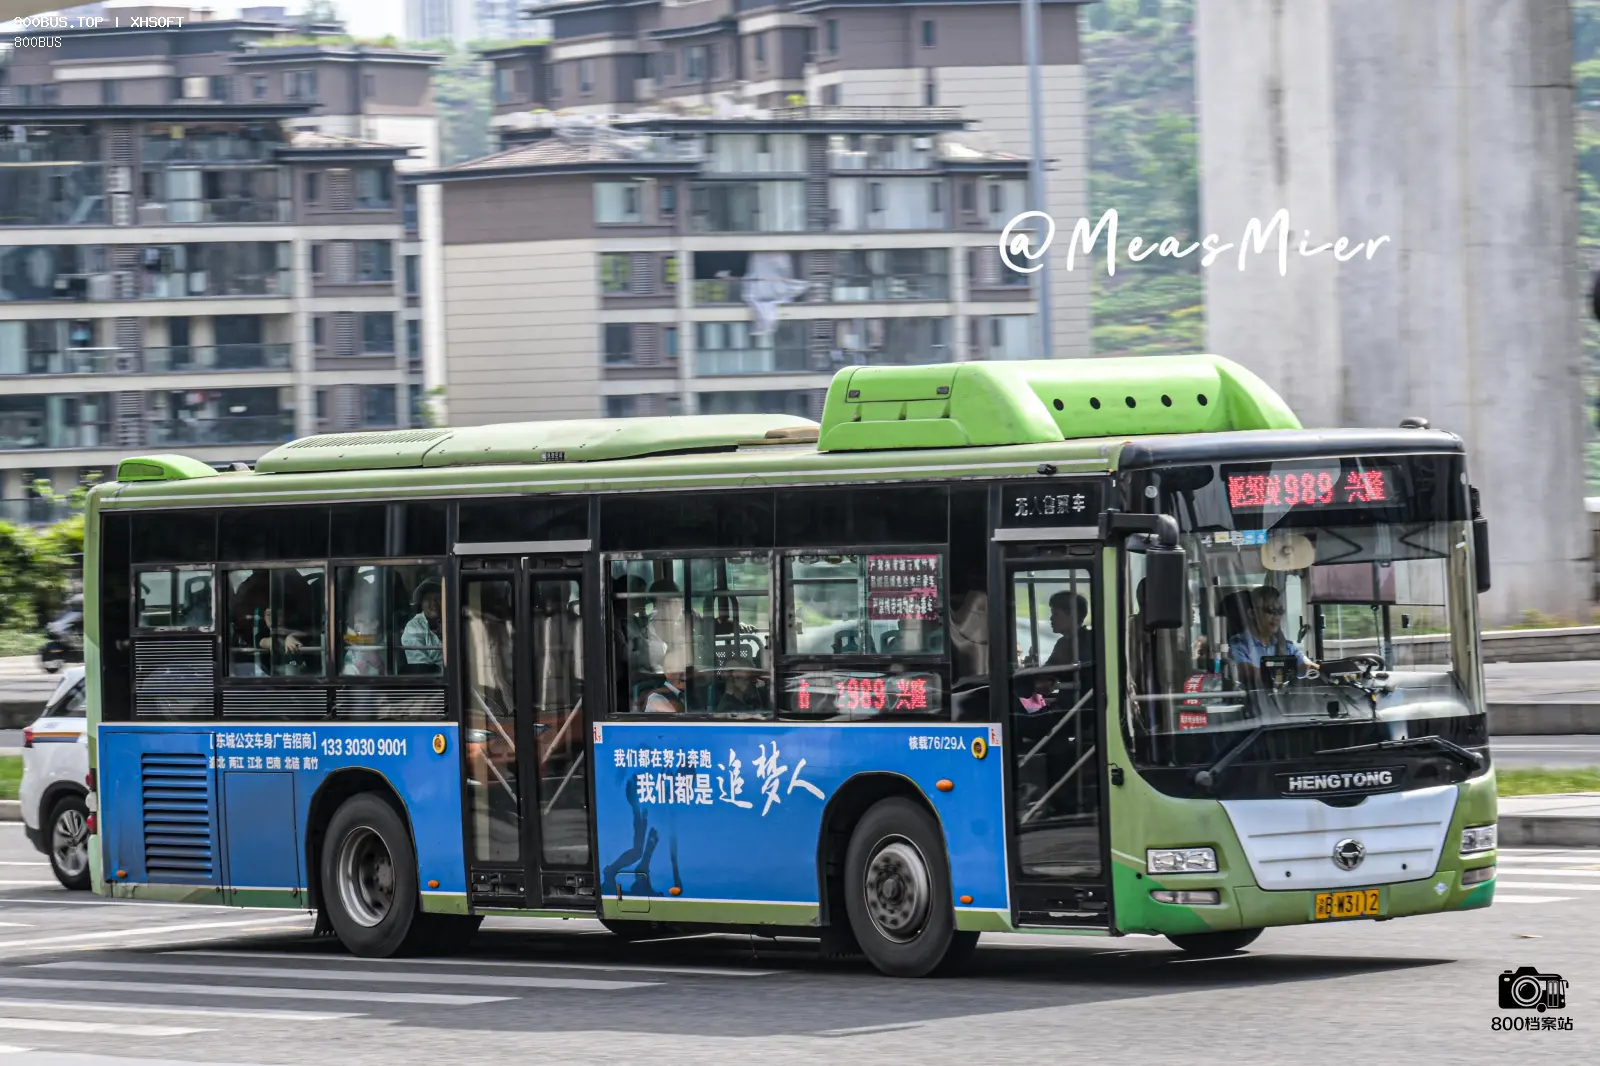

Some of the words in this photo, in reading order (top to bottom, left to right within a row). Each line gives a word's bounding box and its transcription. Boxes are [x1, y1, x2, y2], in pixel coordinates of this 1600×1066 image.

[1284, 472, 1333, 505] 989
[896, 678, 928, 710] 兴隆
[321, 739, 343, 756] 133
[345, 739, 376, 755] 3030
[378, 738, 407, 755] 9001
[908, 735, 967, 750] 核载76/29人
[247, 757, 263, 769] 江北
[266, 757, 281, 769] 巴南
[614, 748, 712, 769] 我们都在努力奔跑
[1288, 771, 1393, 791] HENGTONG
